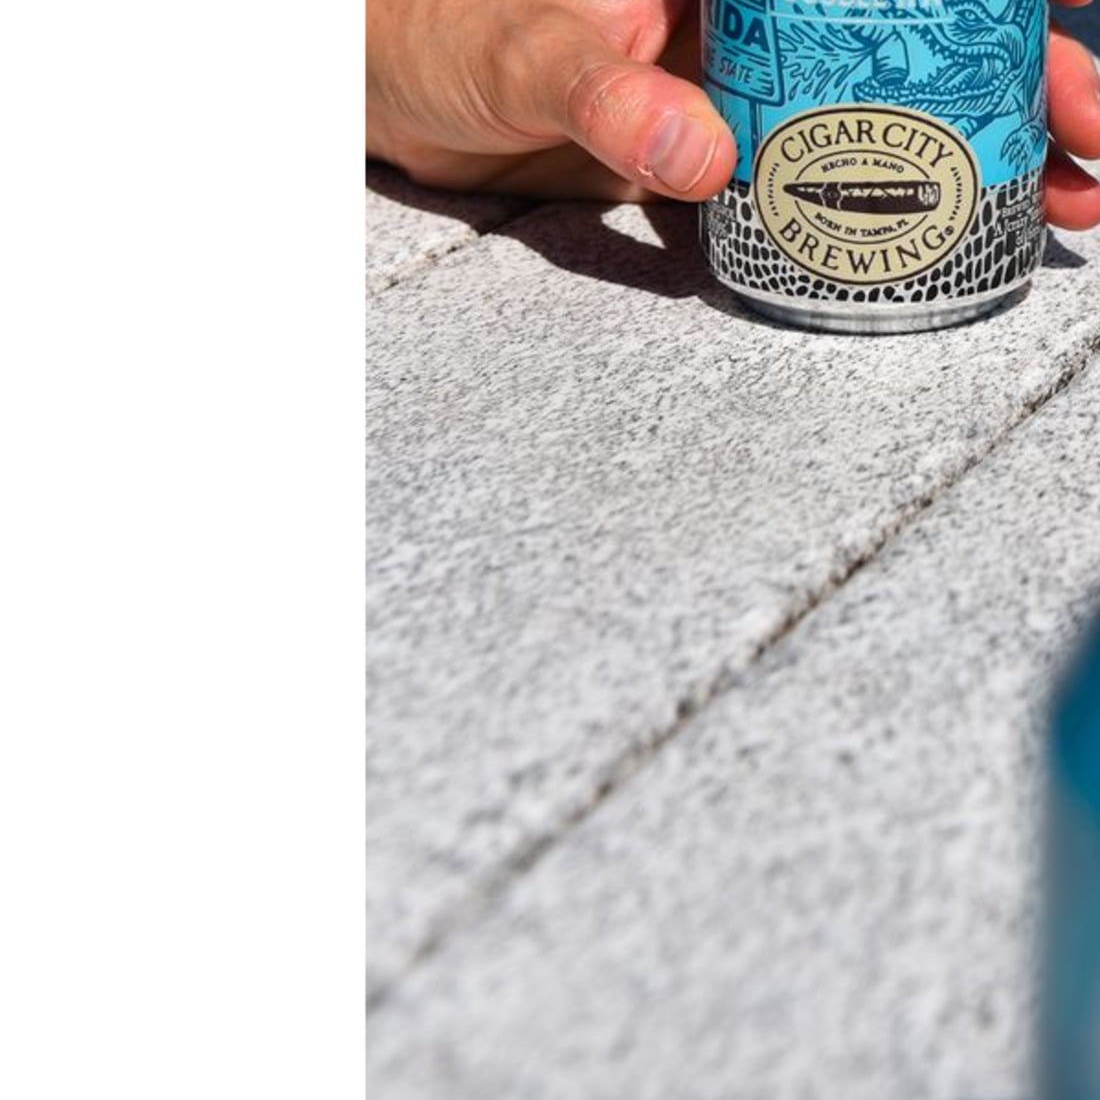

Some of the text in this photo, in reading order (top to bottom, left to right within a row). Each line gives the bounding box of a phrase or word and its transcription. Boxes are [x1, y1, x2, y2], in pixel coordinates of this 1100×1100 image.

[780, 119, 954, 168] CIGAR CITY
[820, 157, 905, 174] HECHO A MANO
[814, 211, 843, 231] BORN
[844, 226, 858, 236] IN
[779, 216, 948, 276] BREWING
